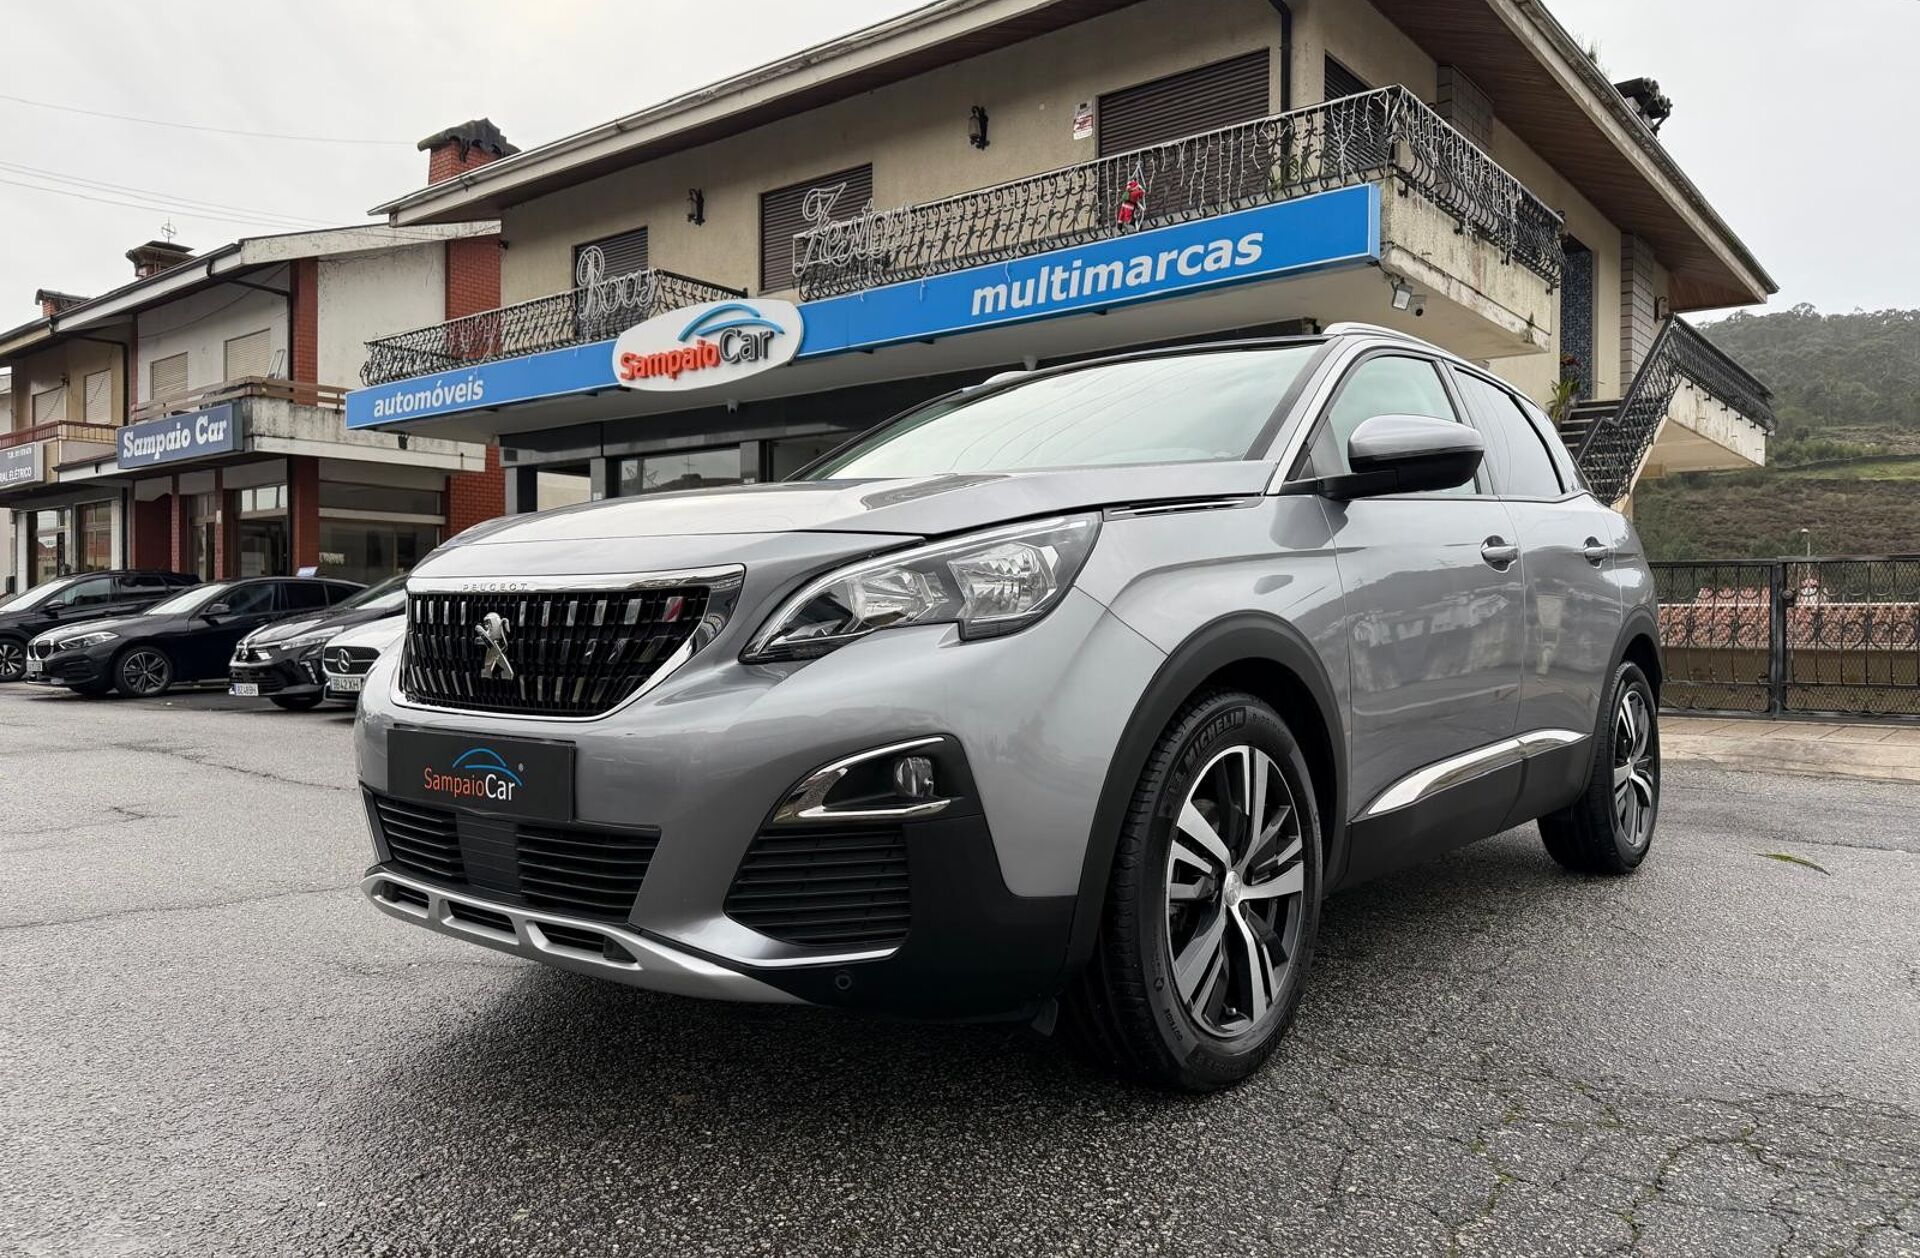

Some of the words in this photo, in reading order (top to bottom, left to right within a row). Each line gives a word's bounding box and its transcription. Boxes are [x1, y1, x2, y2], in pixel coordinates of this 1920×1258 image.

[971, 232, 1264, 316] multimarcas
[620, 327, 775, 380] SampaioCar
[373, 375, 484, 418] automóveis
[123, 422, 192, 460] Sampaio
[195, 415, 228, 445] Car
[462, 582, 528, 592] PEUGEOT
[1184, 710, 1245, 771] MICHELIN
[424, 767, 516, 800] SampaioCar
